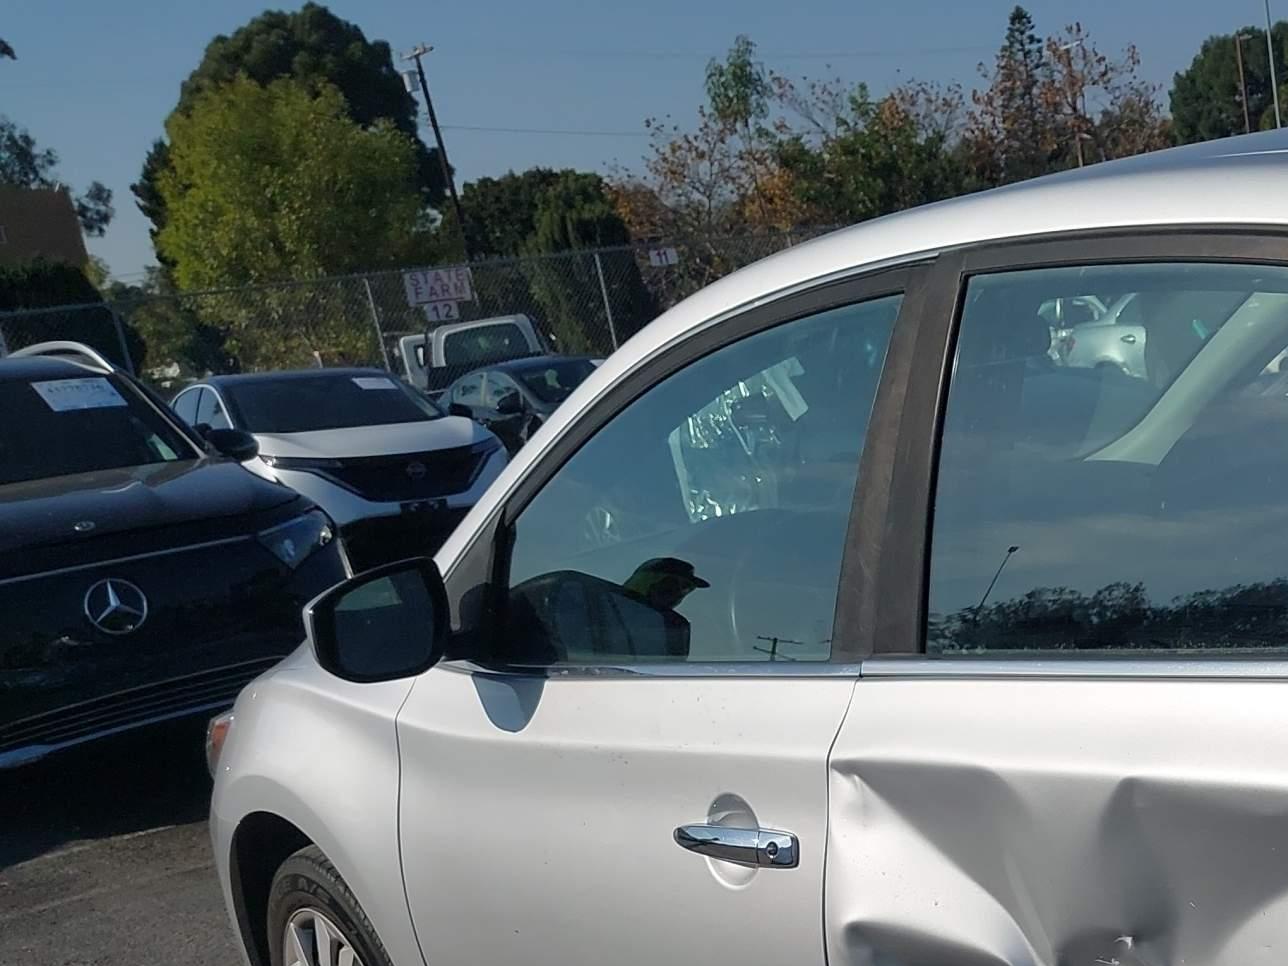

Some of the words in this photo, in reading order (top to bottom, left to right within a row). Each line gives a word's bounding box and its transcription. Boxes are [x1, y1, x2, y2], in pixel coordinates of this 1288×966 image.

[655, 249, 670, 264] 11
[408, 268, 465, 288] STATE
[414, 282, 466, 299] FARM
[432, 303, 454, 320] 12
